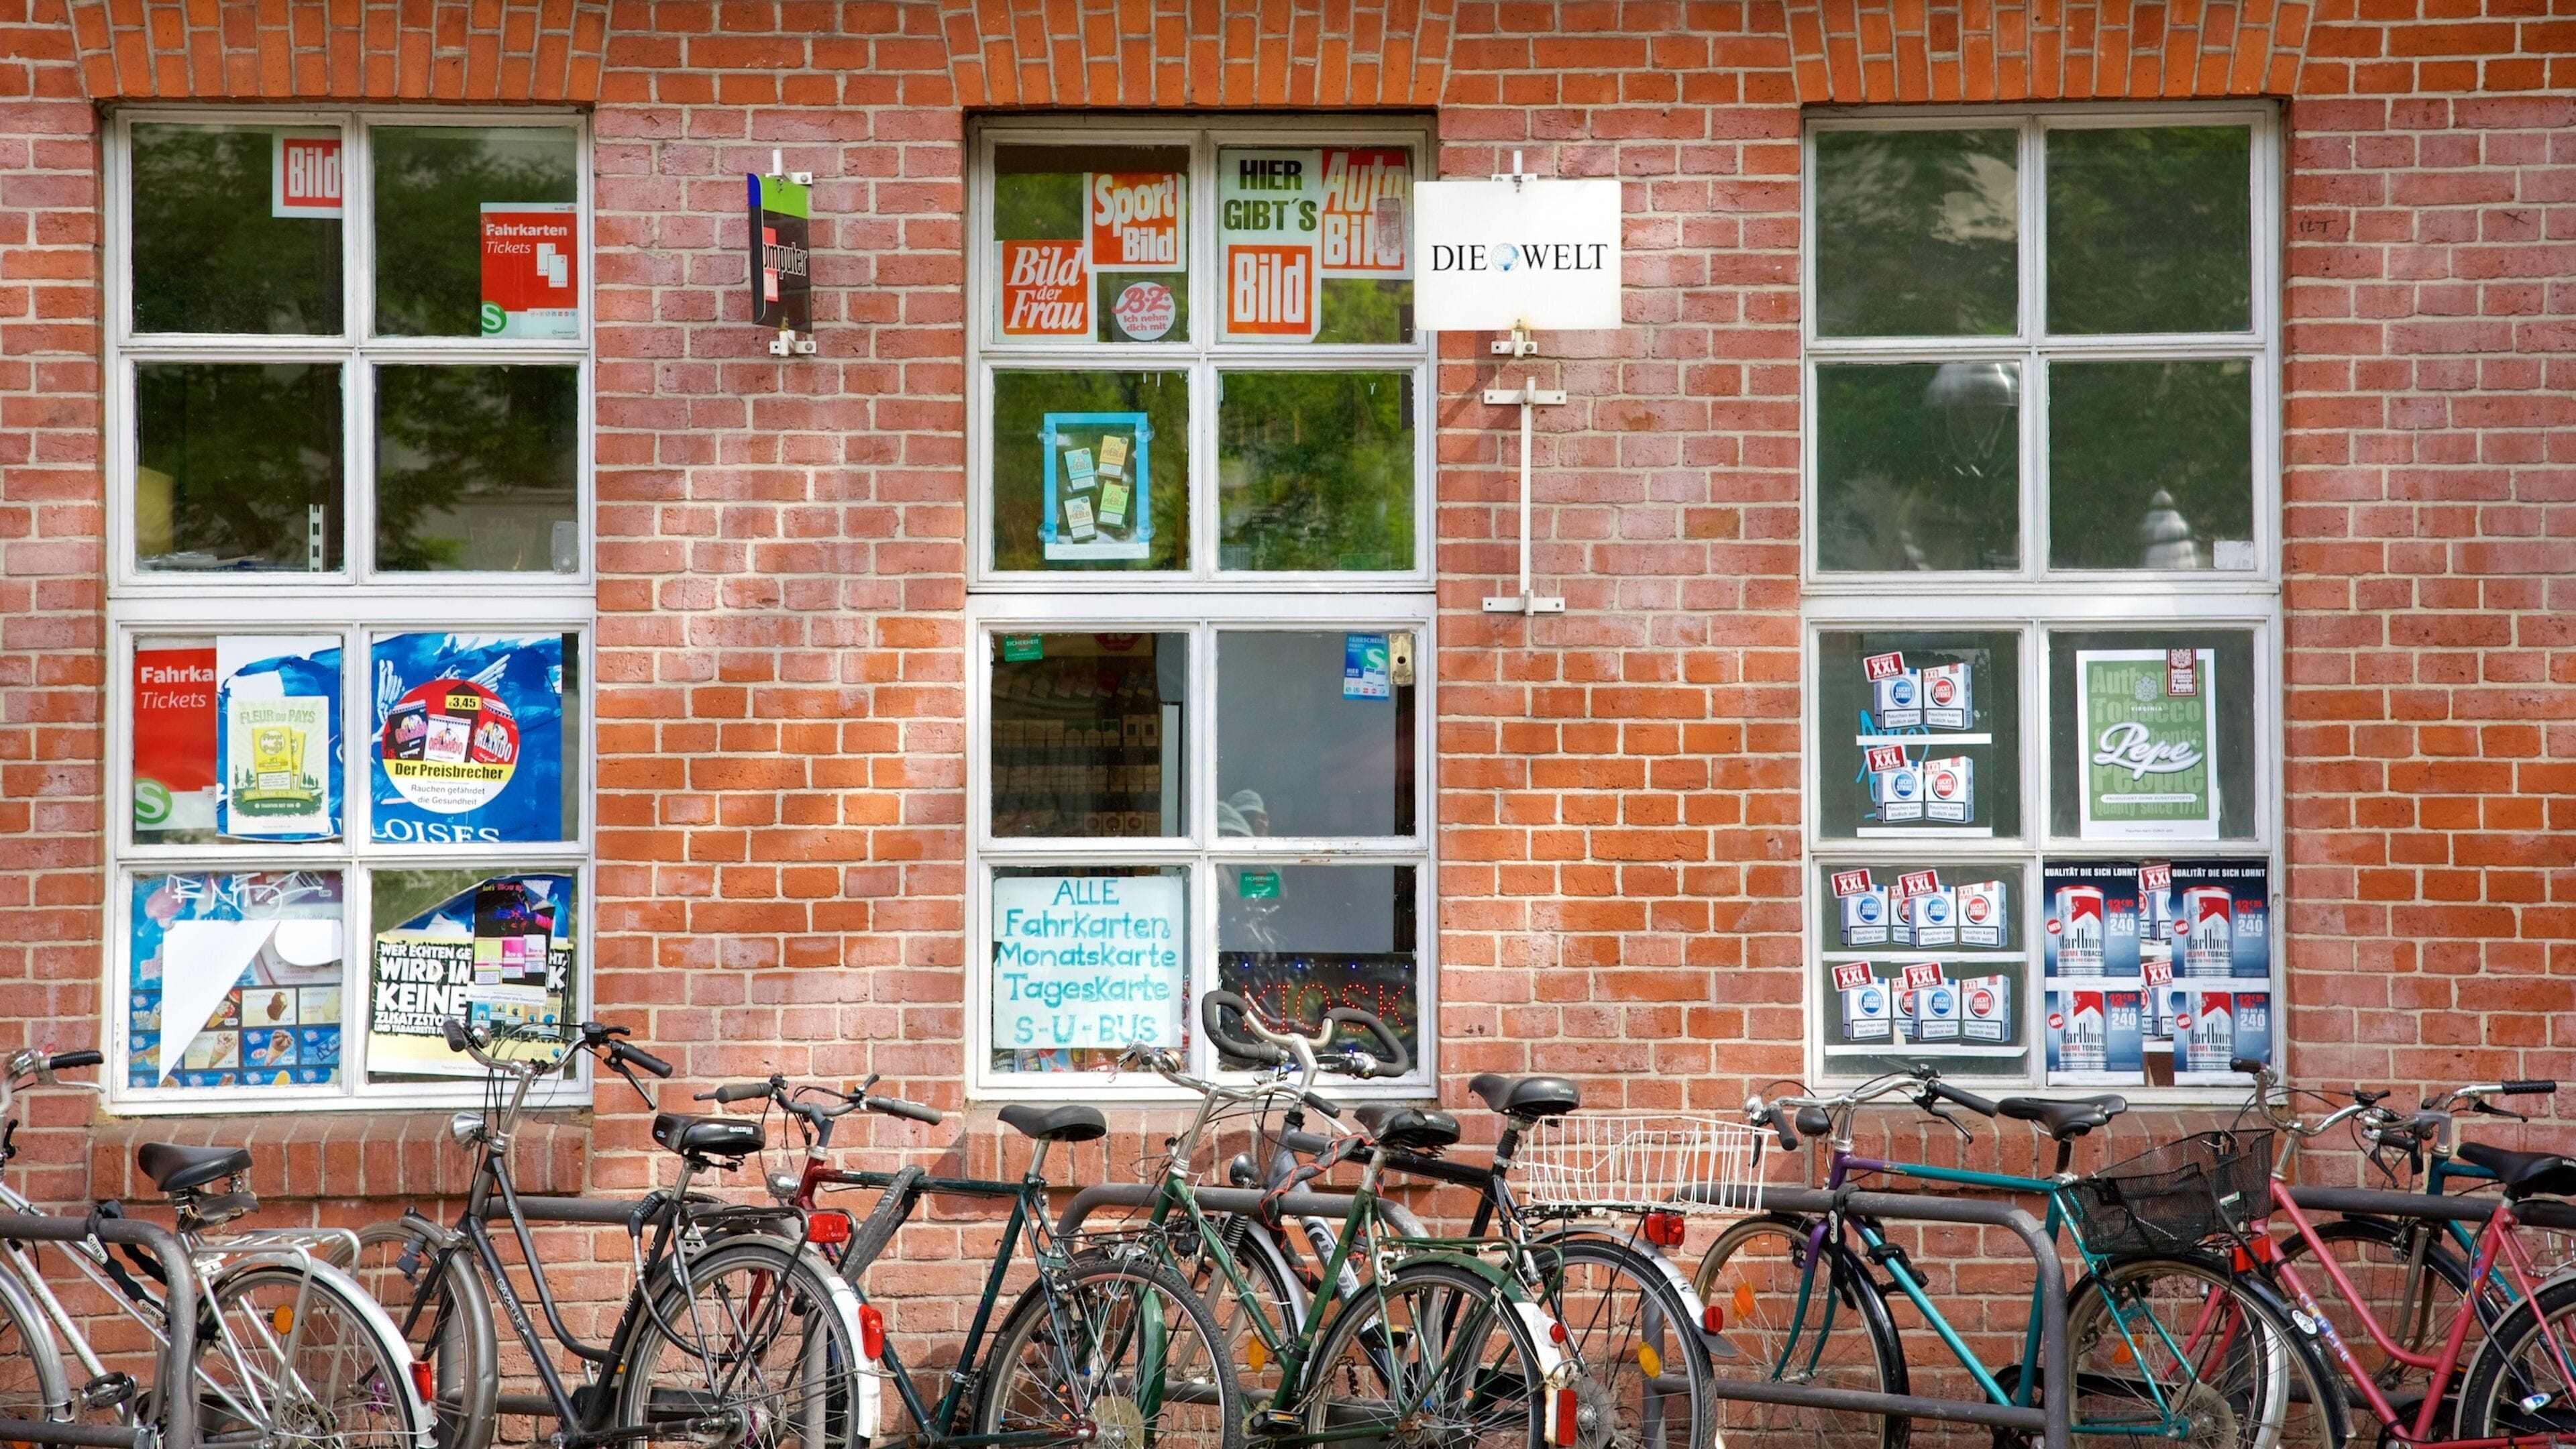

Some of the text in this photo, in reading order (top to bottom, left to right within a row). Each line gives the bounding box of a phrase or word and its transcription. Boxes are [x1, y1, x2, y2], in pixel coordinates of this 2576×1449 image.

[288, 147, 340, 198] Bild
[1240, 160, 1302, 190] HIER
[1322, 152, 1405, 212] Auto
[1095, 174, 1175, 237] Sport
[486, 223, 568, 236] Fahrkarten
[486, 241, 531, 254] Tickets
[1122, 227, 1175, 262] Bild
[763, 241, 807, 280] omputer
[1432, 244, 1608, 271] DIE WELT
[1006, 246, 1084, 286] Bild
[1036, 286, 1062, 301] der
[1234, 253, 1305, 323] Bild
[1006, 290, 1084, 329] Frau
[1124, 315, 1138, 323] Ich
[1127, 323, 1146, 331] dich
[141, 665, 216, 684] Fahrka
[1872, 660, 1898, 676] XXL
[142, 692, 207, 709] Tickets
[240, 710, 274, 724] FLEUR
[288, 709, 315, 723] PAYS
[2091, 698, 2201, 723] Tobacco
[474, 728, 512, 761] ORLANDO
[2093, 722, 2203, 781] Pepe
[1874, 753, 1900, 769] XXL
[394, 763, 504, 779] Der Preisbrecher
[411, 784, 485, 795] Rauchen gefährdet
[432, 796, 476, 805] Gesundheit
[2045, 867, 2137, 877] QUALITÄT DIE SICH LOHNT
[2172, 867, 2206, 877] QUALITÄT
[2222, 869, 2239, 877] SICH
[2241, 869, 2265, 877] LOHNT
[1051, 879, 1120, 905] ALLE
[1839, 877, 1865, 893] XXL
[1907, 879, 1933, 894] XXL
[2047, 922, 2061, 932] NEU
[2110, 918, 2135, 931] 240
[2175, 922, 2189, 933] NEU
[2238, 919, 2263, 932] 240
[2058, 928, 2103, 949] Marlboro
[2186, 928, 2231, 949] Marlboro
[380, 944, 407, 957] WER
[409, 945, 453, 960] ECHTEN
[456, 947, 472, 961] GE
[380, 957, 444, 983] WIRD
[1841, 971, 1868, 985] XXL
[1911, 972, 1938, 987] XXL
[376, 983, 467, 1015] KEINE
[1244, 984, 1407, 1033] KIOSK
[375, 1011, 466, 1027] ZUSATZSTOE
[2049, 1016, 2063, 1026] NEU
[2112, 1013, 2137, 1026] 240
[2178, 1017, 2191, 1026] NEU
[2240, 1014, 2265, 1026] 240
[374, 1024, 391, 1032] UND
[392, 1024, 436, 1034] TABAKRESTE
[2060, 1022, 2105, 1043] Marlboro
[2188, 1023, 2233, 1044] Marlboro
[496, 1278, 525, 1329] GAZELLE
